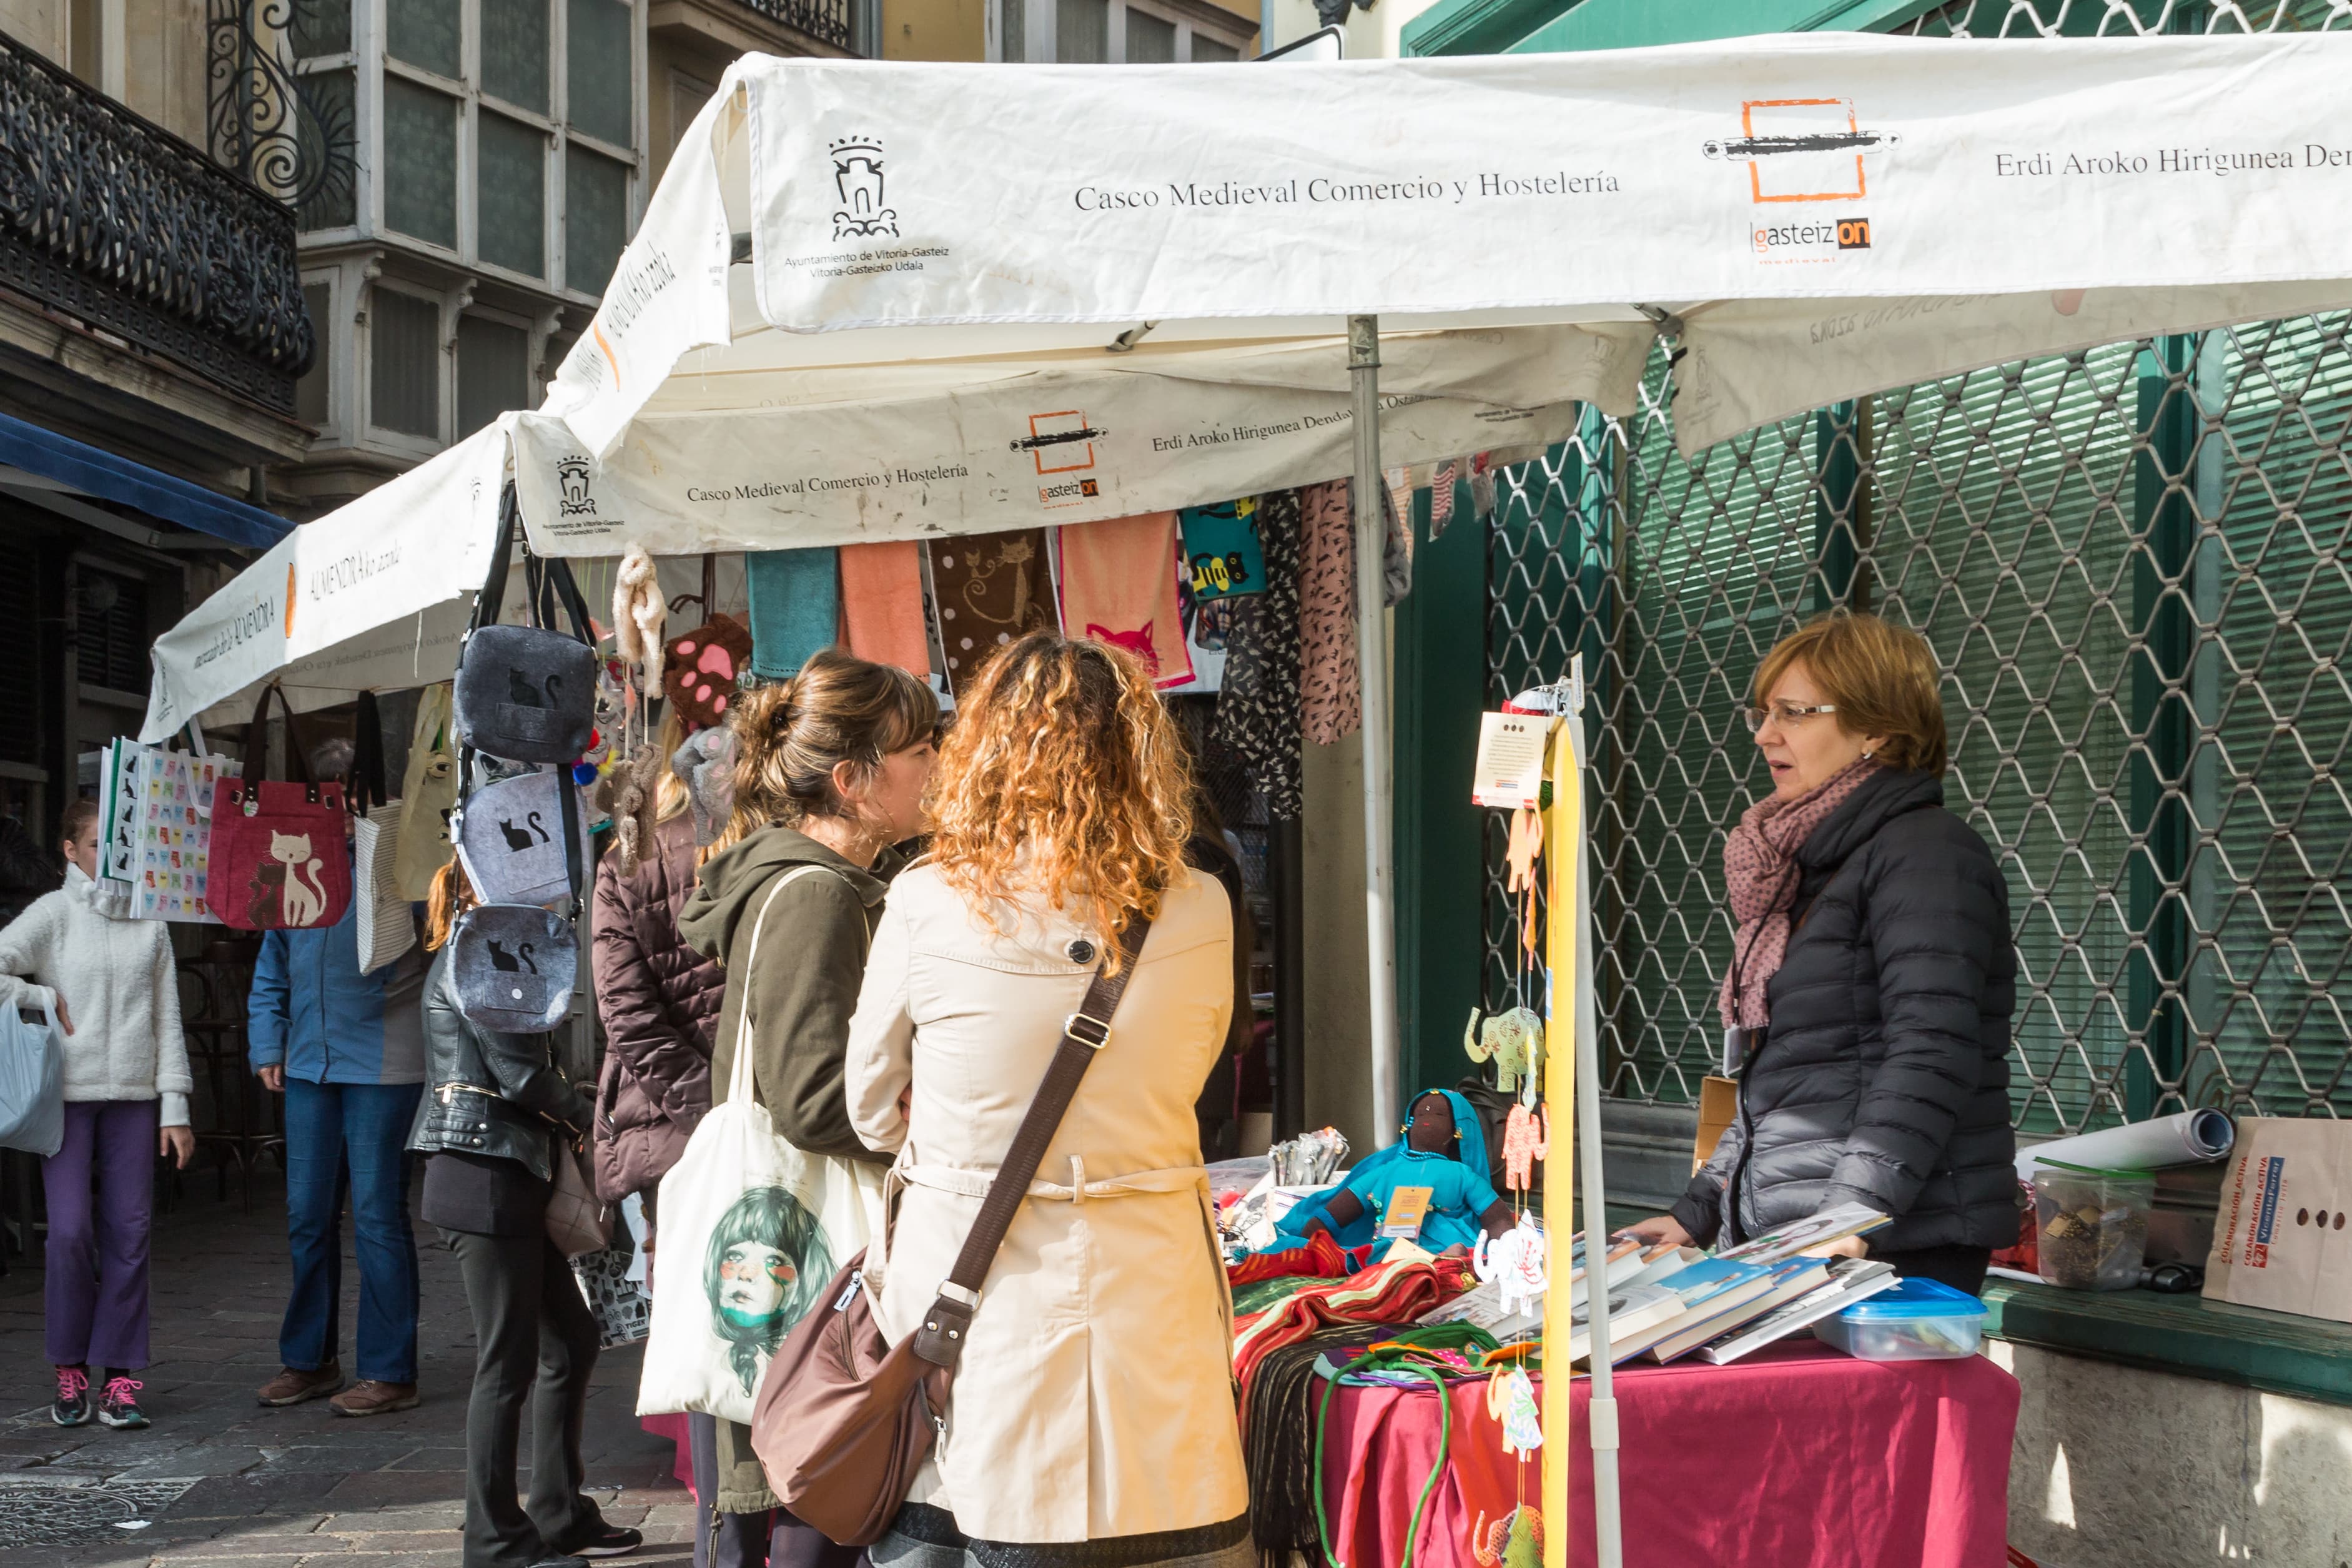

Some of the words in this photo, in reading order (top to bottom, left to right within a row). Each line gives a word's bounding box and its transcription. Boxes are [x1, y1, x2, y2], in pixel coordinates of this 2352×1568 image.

[1995, 152, 2053, 177] Erdi
[2062, 150, 2148, 175] Aroko
[2158, 147, 2294, 177] Hirigunea
[1075, 186, 1159, 210] Casco
[1168, 179, 1298, 207] Medieval
[1308, 175, 1443, 202] Comercio
[1453, 180, 1468, 204] y
[1479, 170, 1620, 196] Hostelería
[1754, 220, 1834, 253] gasteiz
[1837, 220, 1870, 245] on
[784, 254, 857, 269] Ayuntamiento
[859, 250, 872, 261] de
[875, 246, 949, 260] Vitoria-Gasteiz
[810, 263, 892, 278] Vitoria-Gasteizko
[896, 260, 924, 272] Udala
[1152, 435, 1182, 451] Erdi
[1187, 430, 1230, 448] Aroko
[1232, 422, 1301, 441] Hirigunea
[687, 488, 731, 502] Casco
[734, 479, 804, 500] Medieval
[808, 472, 881, 492] Comercio
[884, 474, 892, 488] y
[897, 463, 969, 483] Hostelería
[1039, 481, 1081, 503] gasteiz
[2235, 1156, 2249, 1189] ACTIVA
[2257, 1156, 2269, 1190] ACTIVA
[625, 1319, 646, 1329] TIGER
